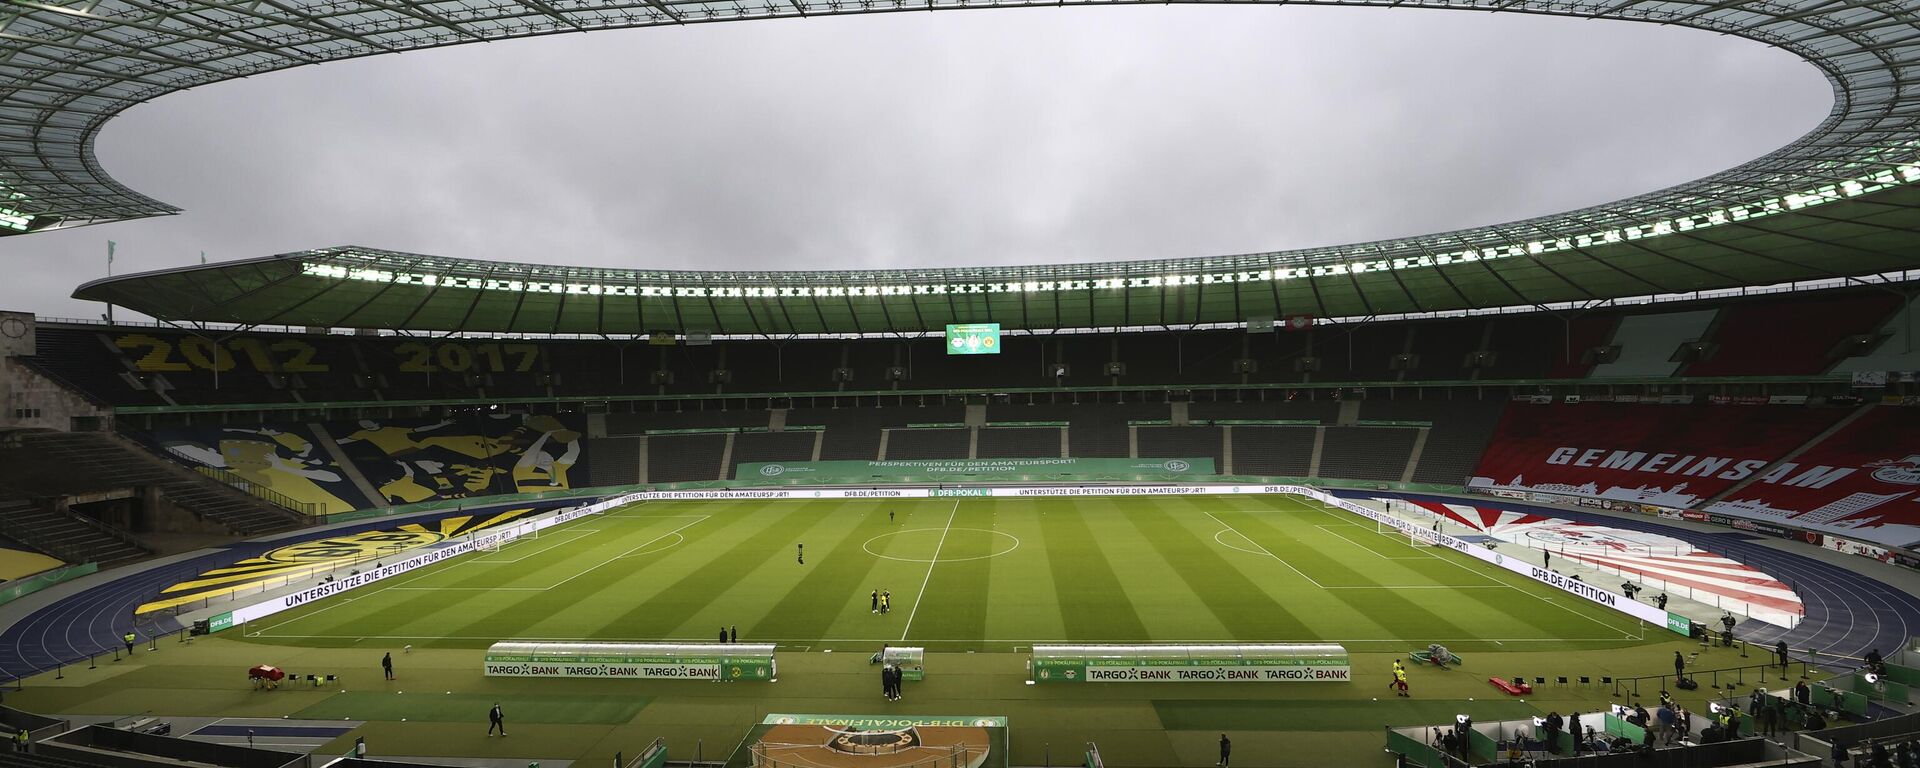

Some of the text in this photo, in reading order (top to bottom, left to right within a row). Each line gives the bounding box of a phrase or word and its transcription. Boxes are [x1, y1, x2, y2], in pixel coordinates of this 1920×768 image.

[115, 334, 329, 371] 2012
[393, 342, 540, 372] 2017
[1546, 447, 1858, 489] GEMEINSAM
[1019, 487, 1067, 495] UNTERSTÜTZE
[1116, 487, 1129, 495] FÜR
[286, 575, 361, 607] UNTERSTÜTZE
[365, 570, 380, 583] DIE
[382, 558, 421, 578] PETITION
[424, 551, 439, 564] FÜR
[441, 547, 456, 557] DEN
[1532, 567, 1616, 606] DFB.DE/PETITION
[210, 616, 232, 628] DFB.DE
[1668, 617, 1689, 631] DFB.DE
